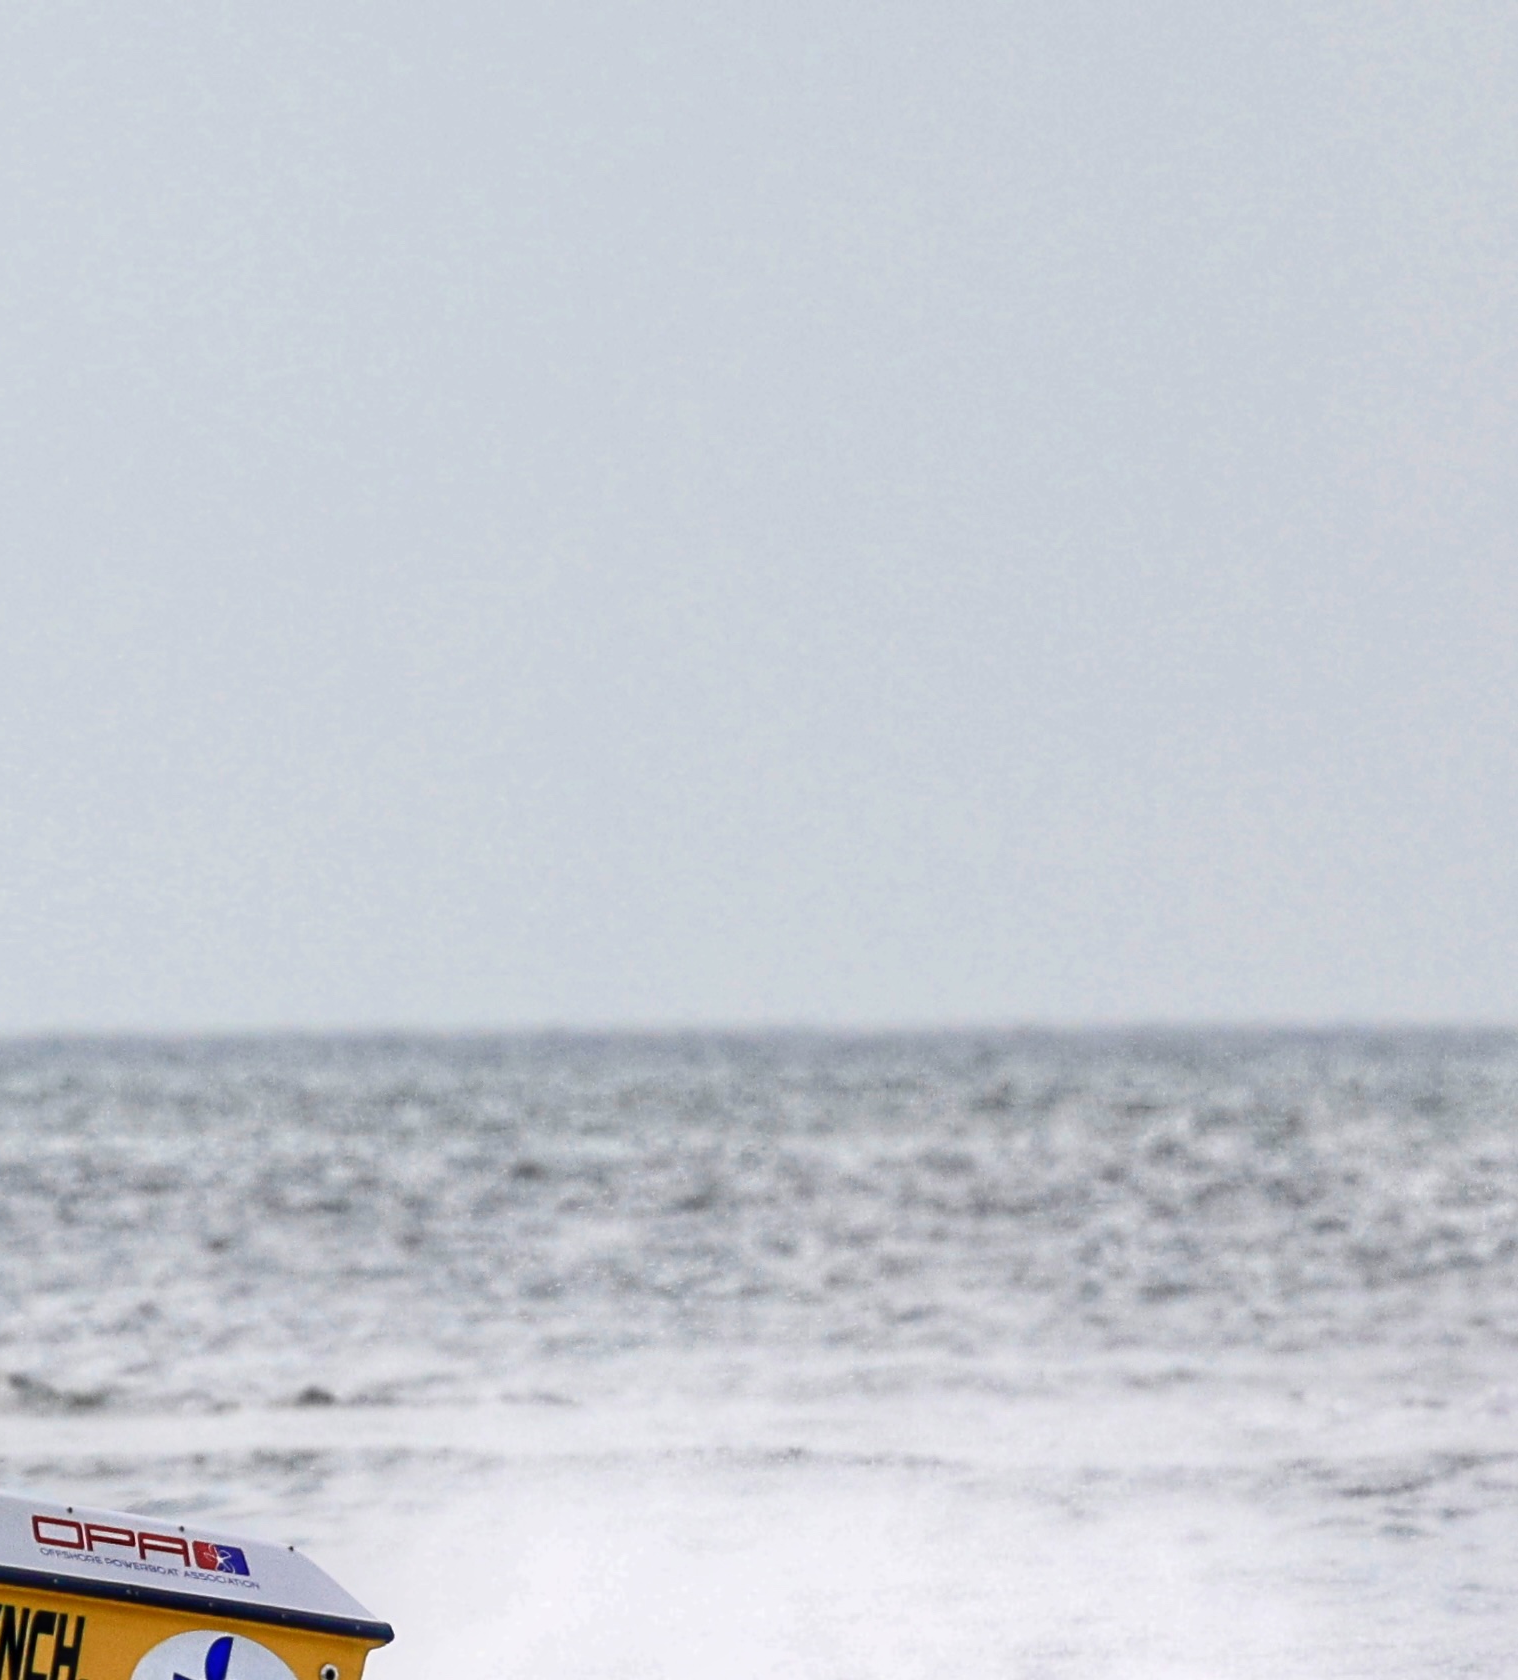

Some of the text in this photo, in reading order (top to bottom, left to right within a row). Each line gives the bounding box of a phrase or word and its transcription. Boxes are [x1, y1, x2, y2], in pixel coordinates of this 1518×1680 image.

[32, 1515, 191, 1567] OPA
[39, 1547, 260, 1590] OFFSHORE POWERBOAT ASSOCIATION
